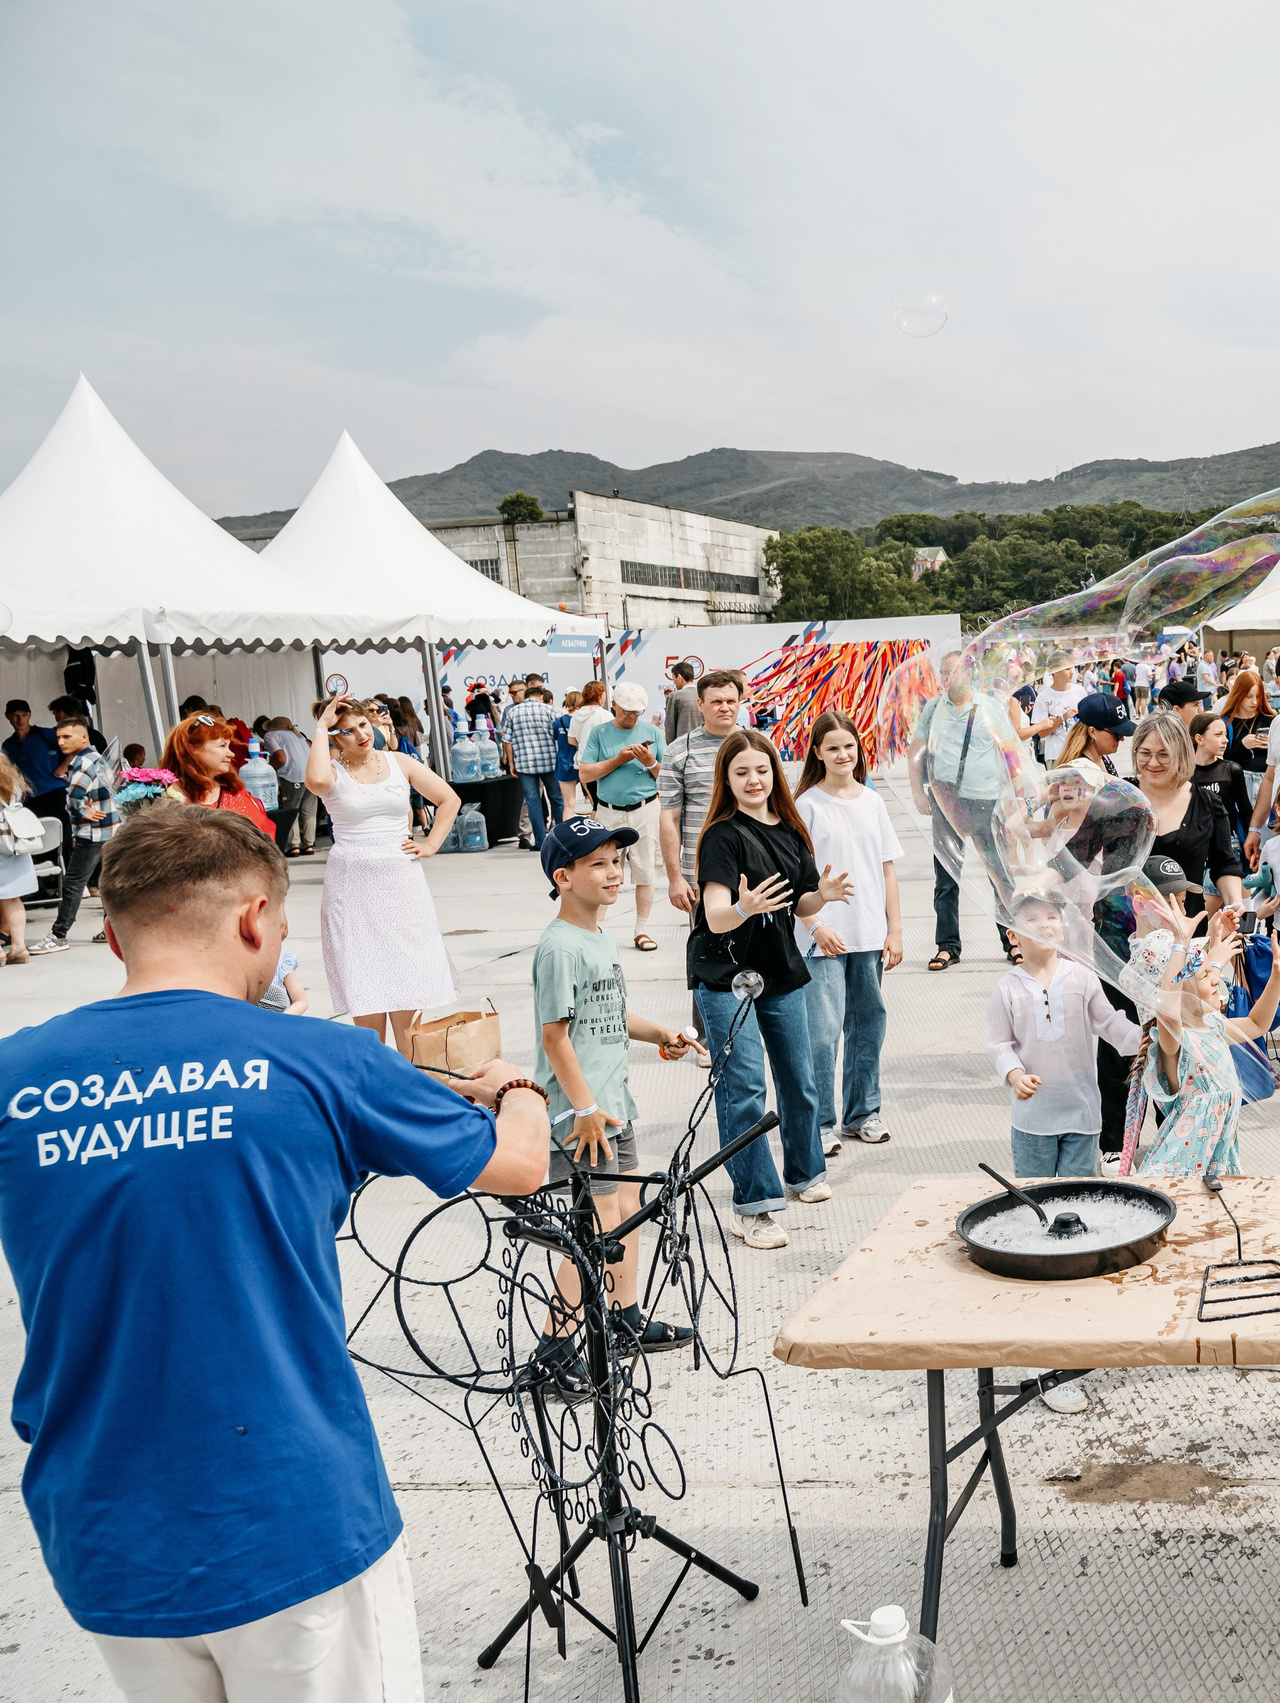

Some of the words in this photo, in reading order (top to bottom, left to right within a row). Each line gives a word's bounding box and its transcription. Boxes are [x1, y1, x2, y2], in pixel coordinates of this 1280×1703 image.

[561, 639, 588, 648] АКВАГРИМ
[7, 1059, 270, 1120] СОЗДАВАЯ
[37, 1105, 234, 1167] БУДУЩЕЕ
